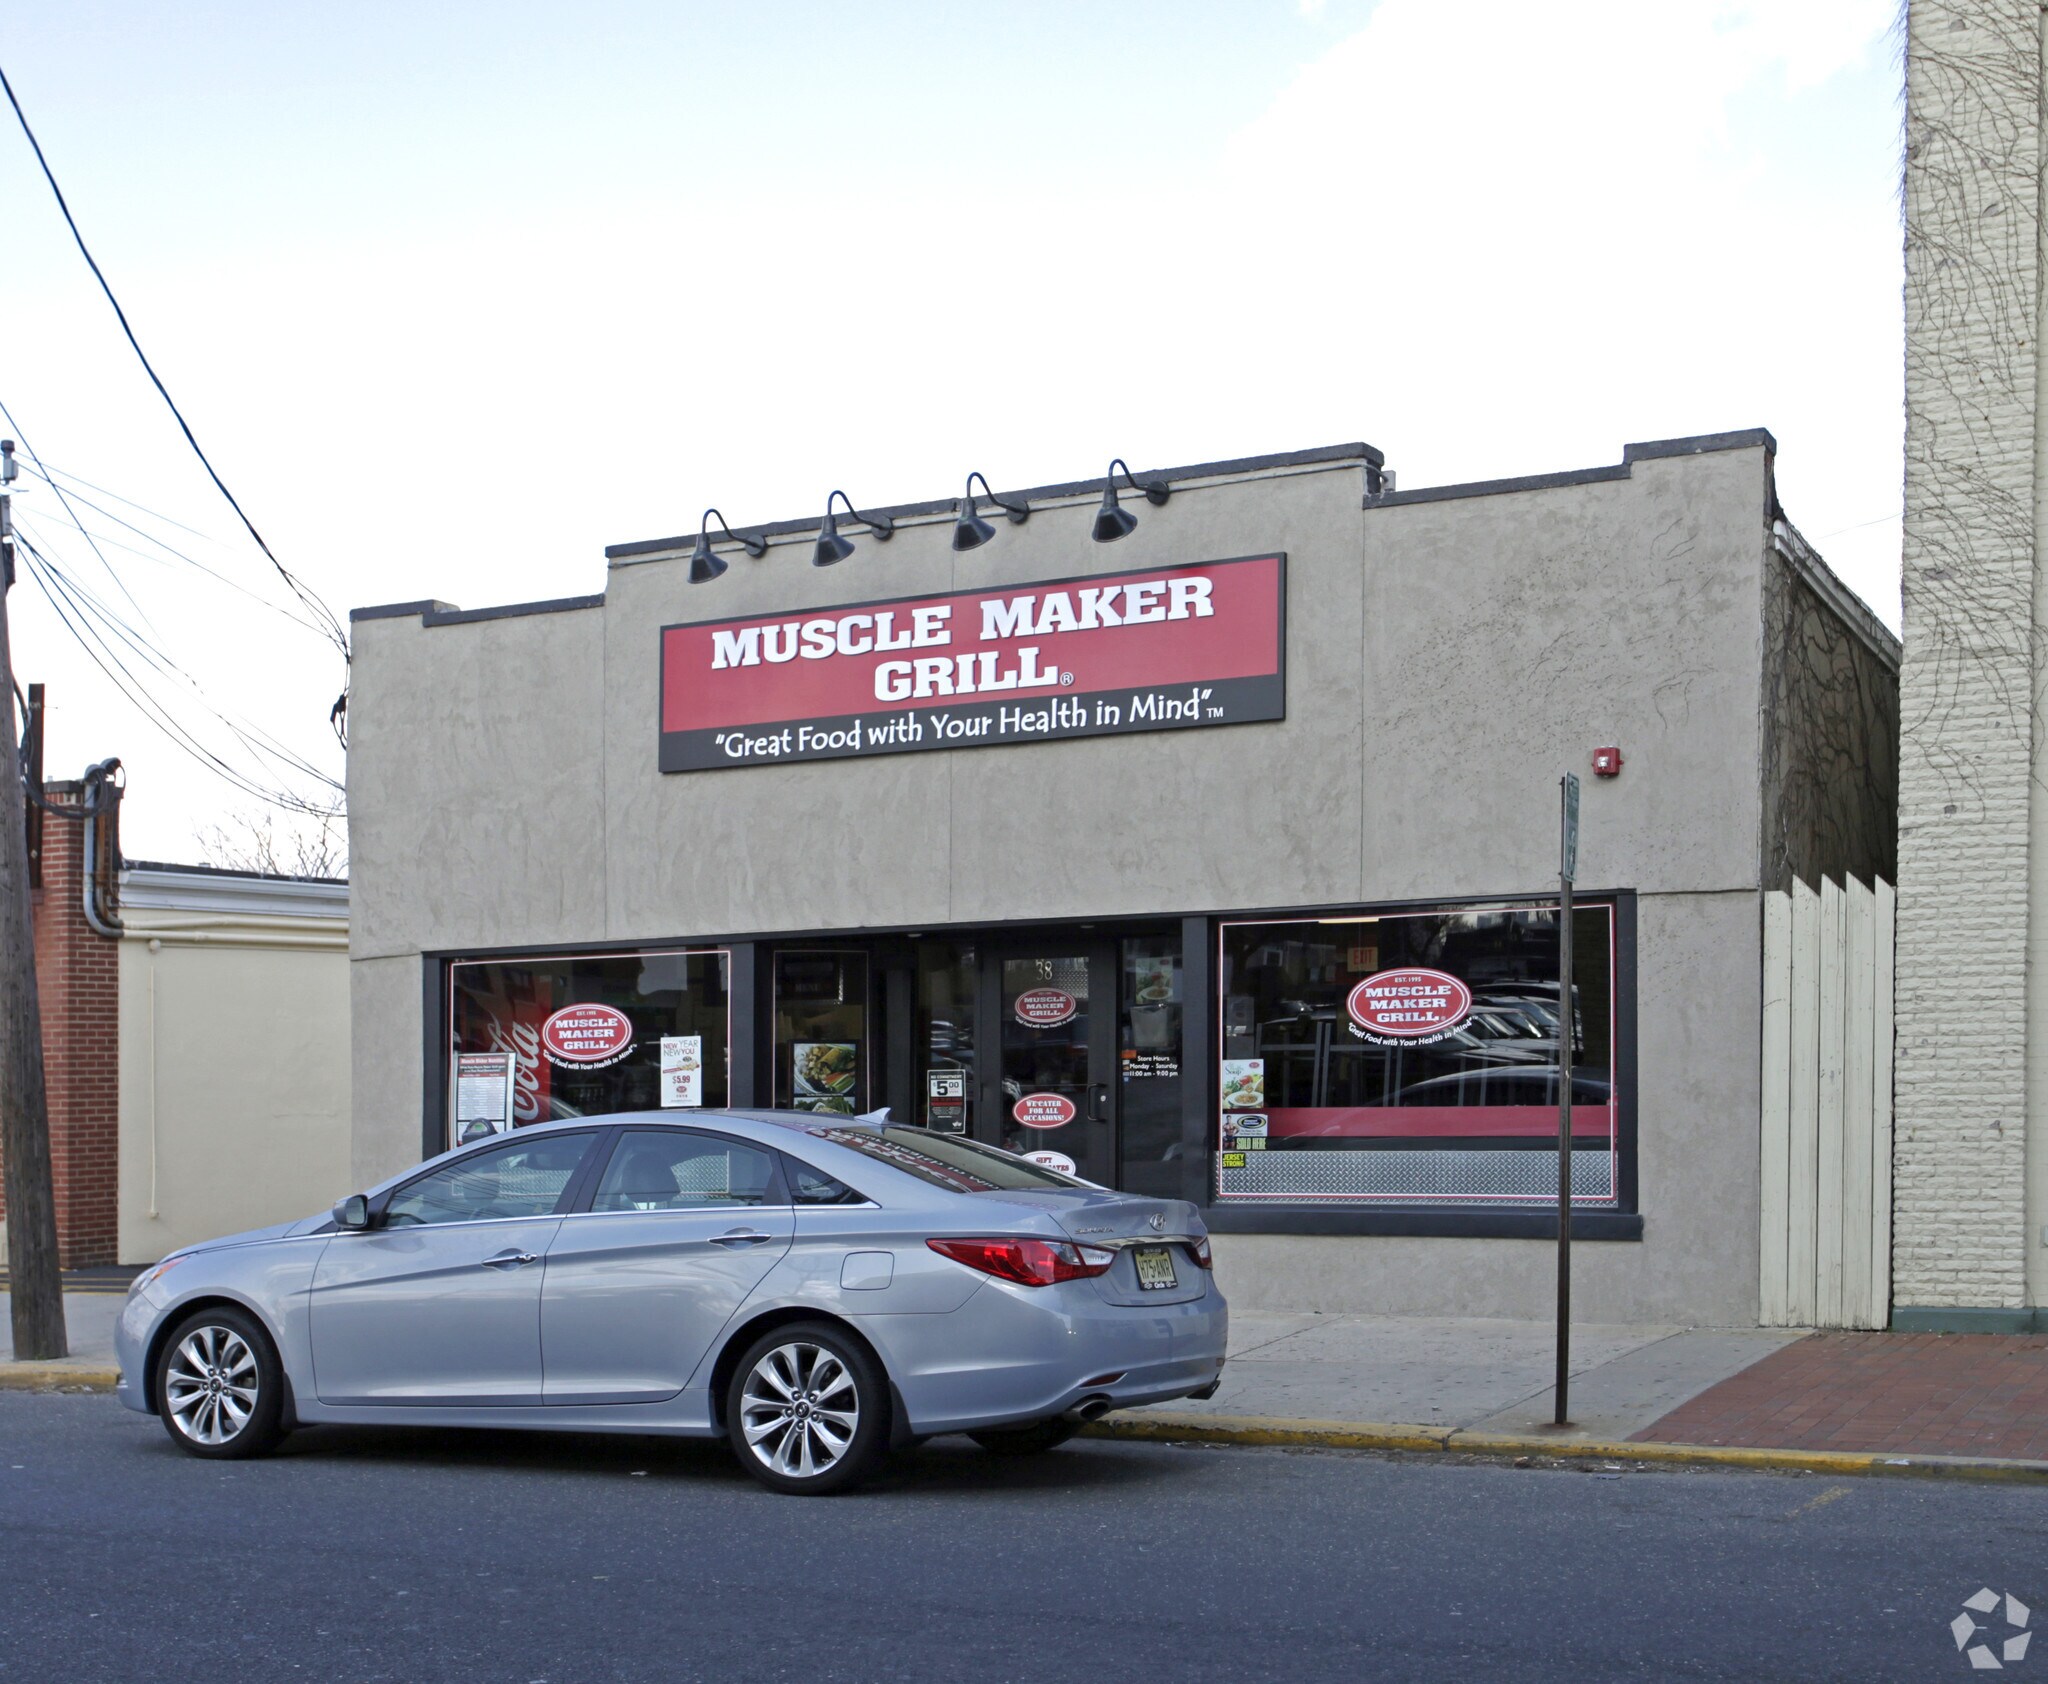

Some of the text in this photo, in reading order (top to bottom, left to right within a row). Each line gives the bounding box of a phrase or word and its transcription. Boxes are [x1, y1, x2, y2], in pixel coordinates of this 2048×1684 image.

[711, 576, 1214, 669] MUSCLE MAKER
[874, 646, 1058, 702] GRILL
[798, 719, 861, 750] Food
[868, 712, 922, 745] with
[930, 713, 992, 738] Your
[1000, 696, 1087, 734] Health
[1096, 700, 1121, 727] in
[1035, 959, 1053, 980] 38
[1365, 985, 1451, 998] MUSCLE
[1369, 998, 1447, 1010] MAKER
[1376, 1011, 1440, 1023] GRILL
[555, 1018, 618, 1029] MUSCLE
[558, 1028, 615, 1039] MAKER
[1364, 1033, 1383, 1045] Food
[1400, 1038, 1418, 1047] Your
[1418, 1033, 1443, 1046] Health
[1444, 1031, 1452, 1039] in
[563, 1040, 610, 1050] GRILL
[679, 1040, 699, 1048] YEAR
[663, 1047, 695, 1057] NEW YOU
[1236, 1138, 1266, 1149] SOLD HERE
